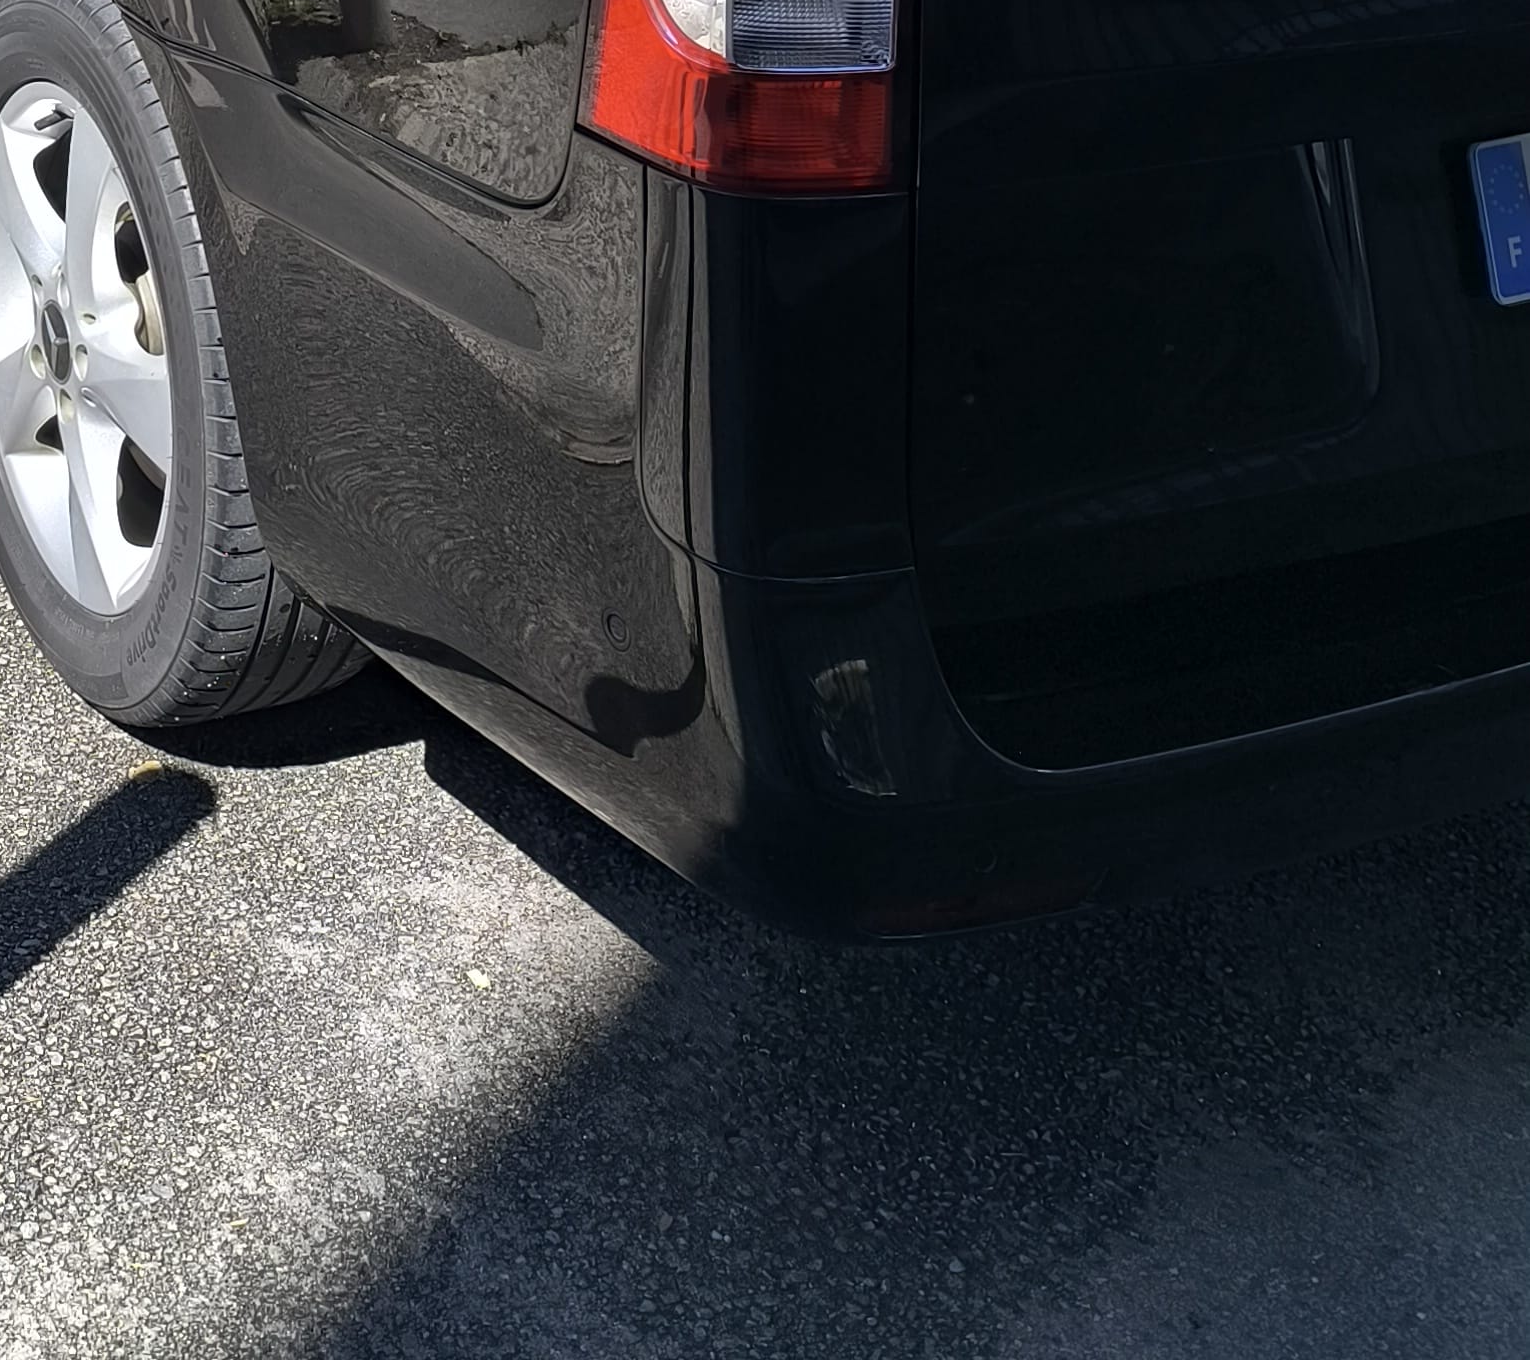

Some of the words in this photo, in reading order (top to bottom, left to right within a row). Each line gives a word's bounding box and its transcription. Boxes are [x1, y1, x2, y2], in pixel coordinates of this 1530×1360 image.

[1507, 234, 1523, 269] F
[172, 426, 191, 547] CEAT
[125, 562, 177, 667] SportDrive
